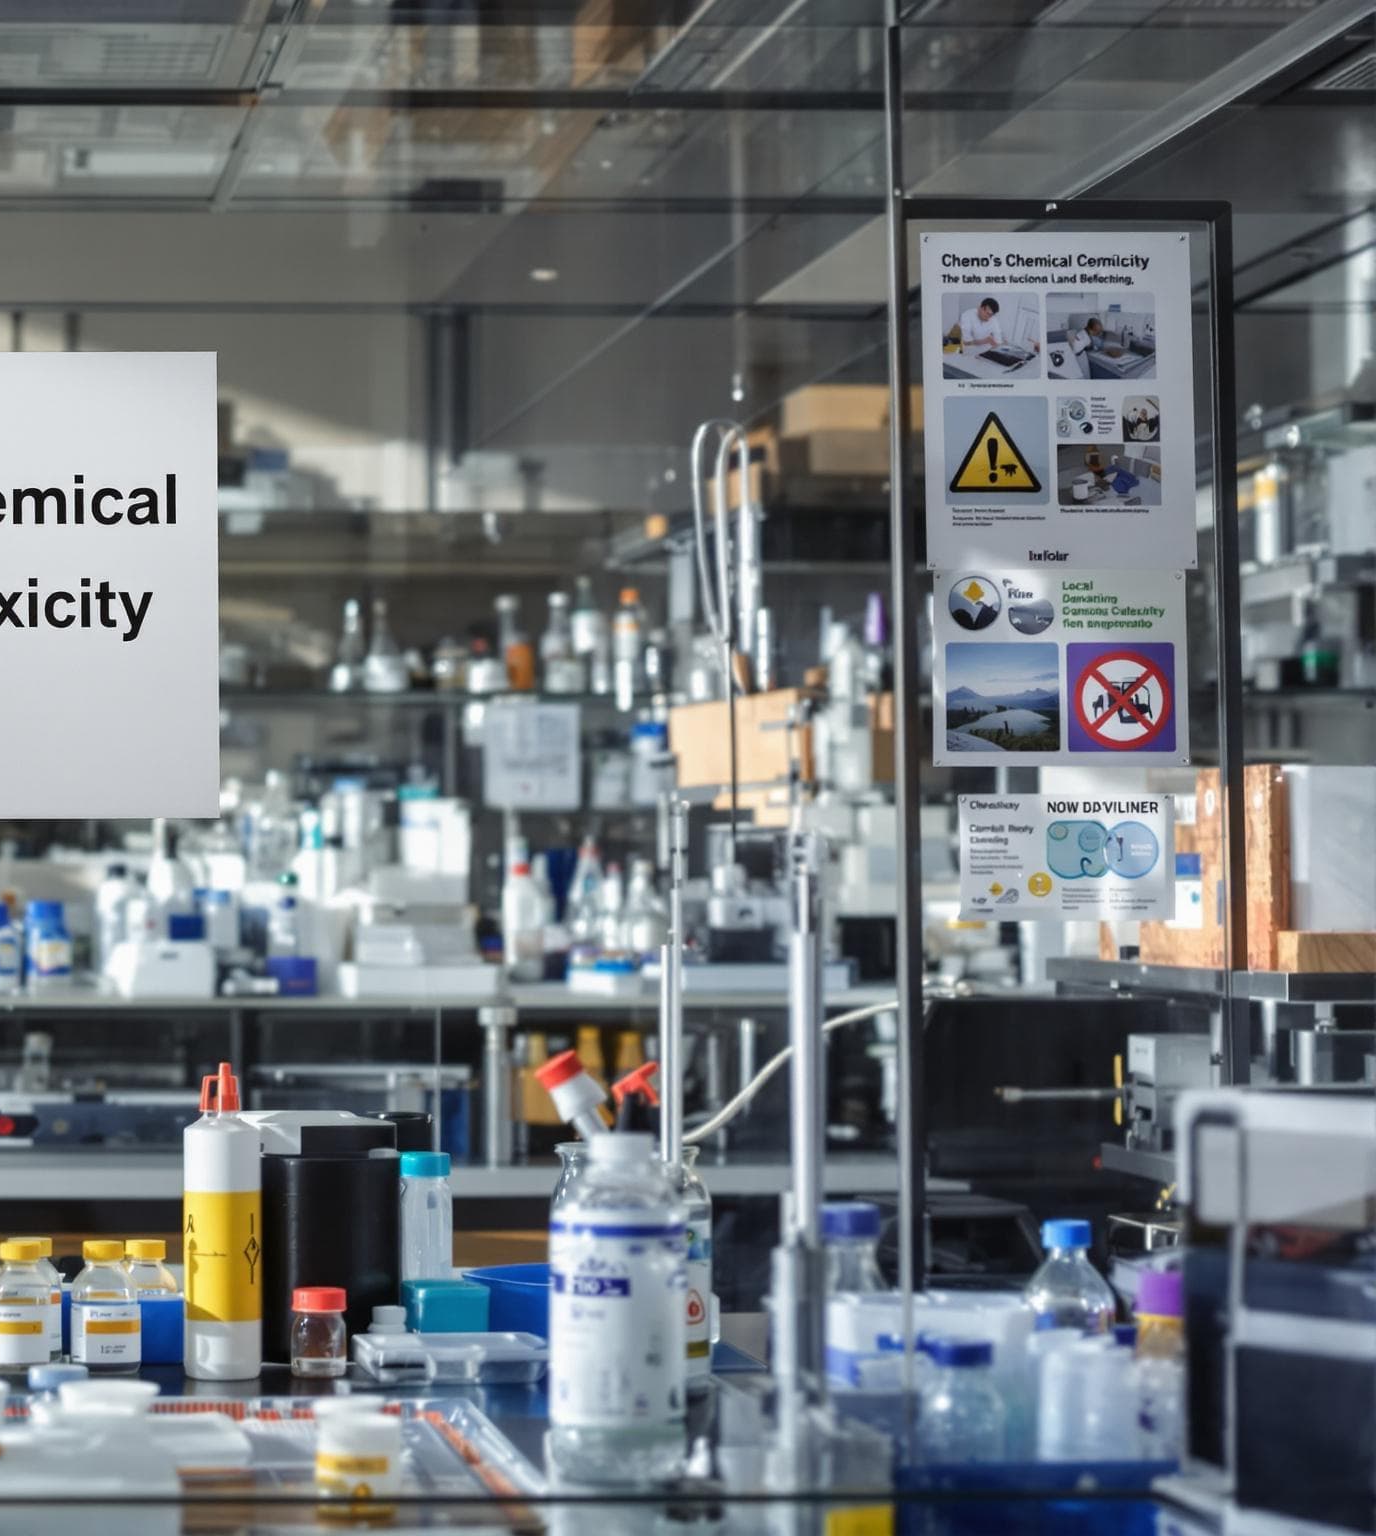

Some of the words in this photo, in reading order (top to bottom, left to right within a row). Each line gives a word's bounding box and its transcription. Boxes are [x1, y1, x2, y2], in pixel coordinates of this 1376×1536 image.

[1005, 253, 1073, 268] Chemical
[941, 274, 959, 284] The
[1062, 580, 1094, 591] Local
[1047, 801, 1079, 814] NOW
